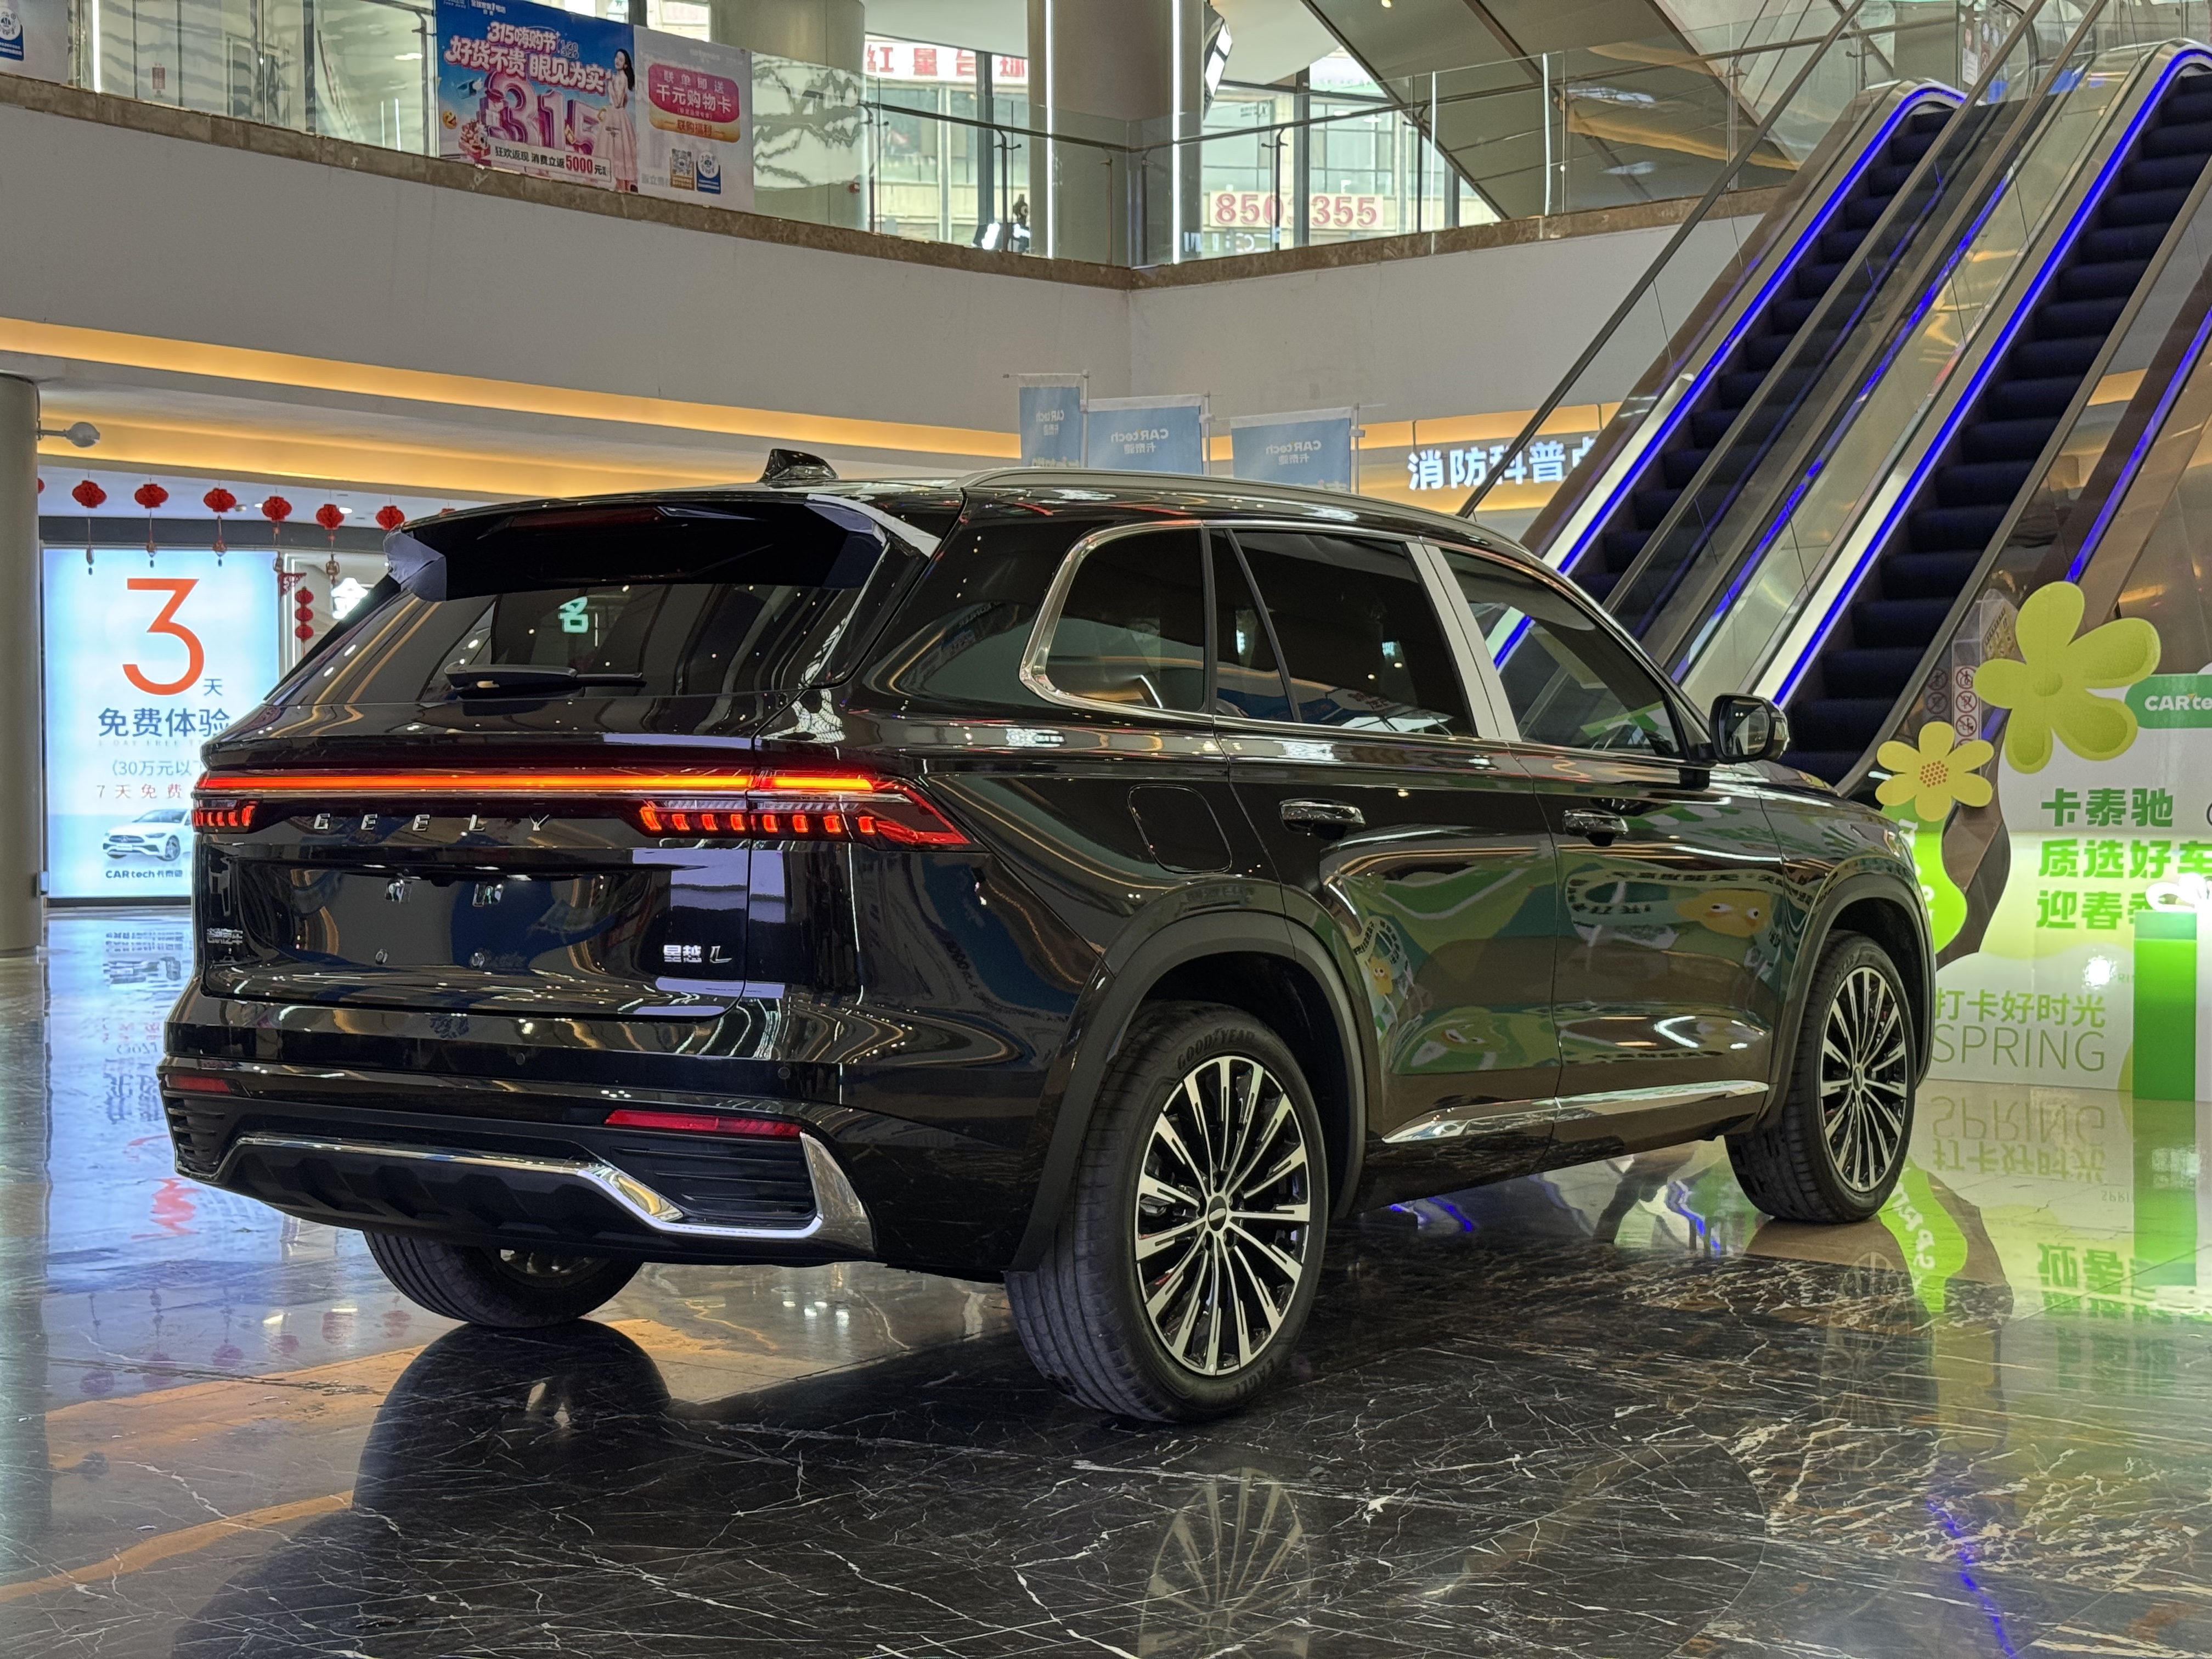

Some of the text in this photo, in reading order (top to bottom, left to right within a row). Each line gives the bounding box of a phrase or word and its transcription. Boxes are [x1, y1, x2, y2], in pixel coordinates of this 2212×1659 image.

[487, 20, 556, 53] 315嗨购节
[444, 35, 527, 78] 好货不贵
[529, 53, 606, 93] 眼见为实
[656, 83, 732, 114] 千元购物卡
[663, 70, 724, 95] 联单即送
[1215, 193, 1377, 227] 850355
[98, 707, 231, 738] 免费体验
[313, 812, 550, 832] GEELY
[2041, 788, 2173, 827] 卡泰驰
[664, 944, 732, 963] 星越 L
[1935, 988, 2106, 1029] 打卡好时光
[1931, 1023, 2106, 1072] SPRING
